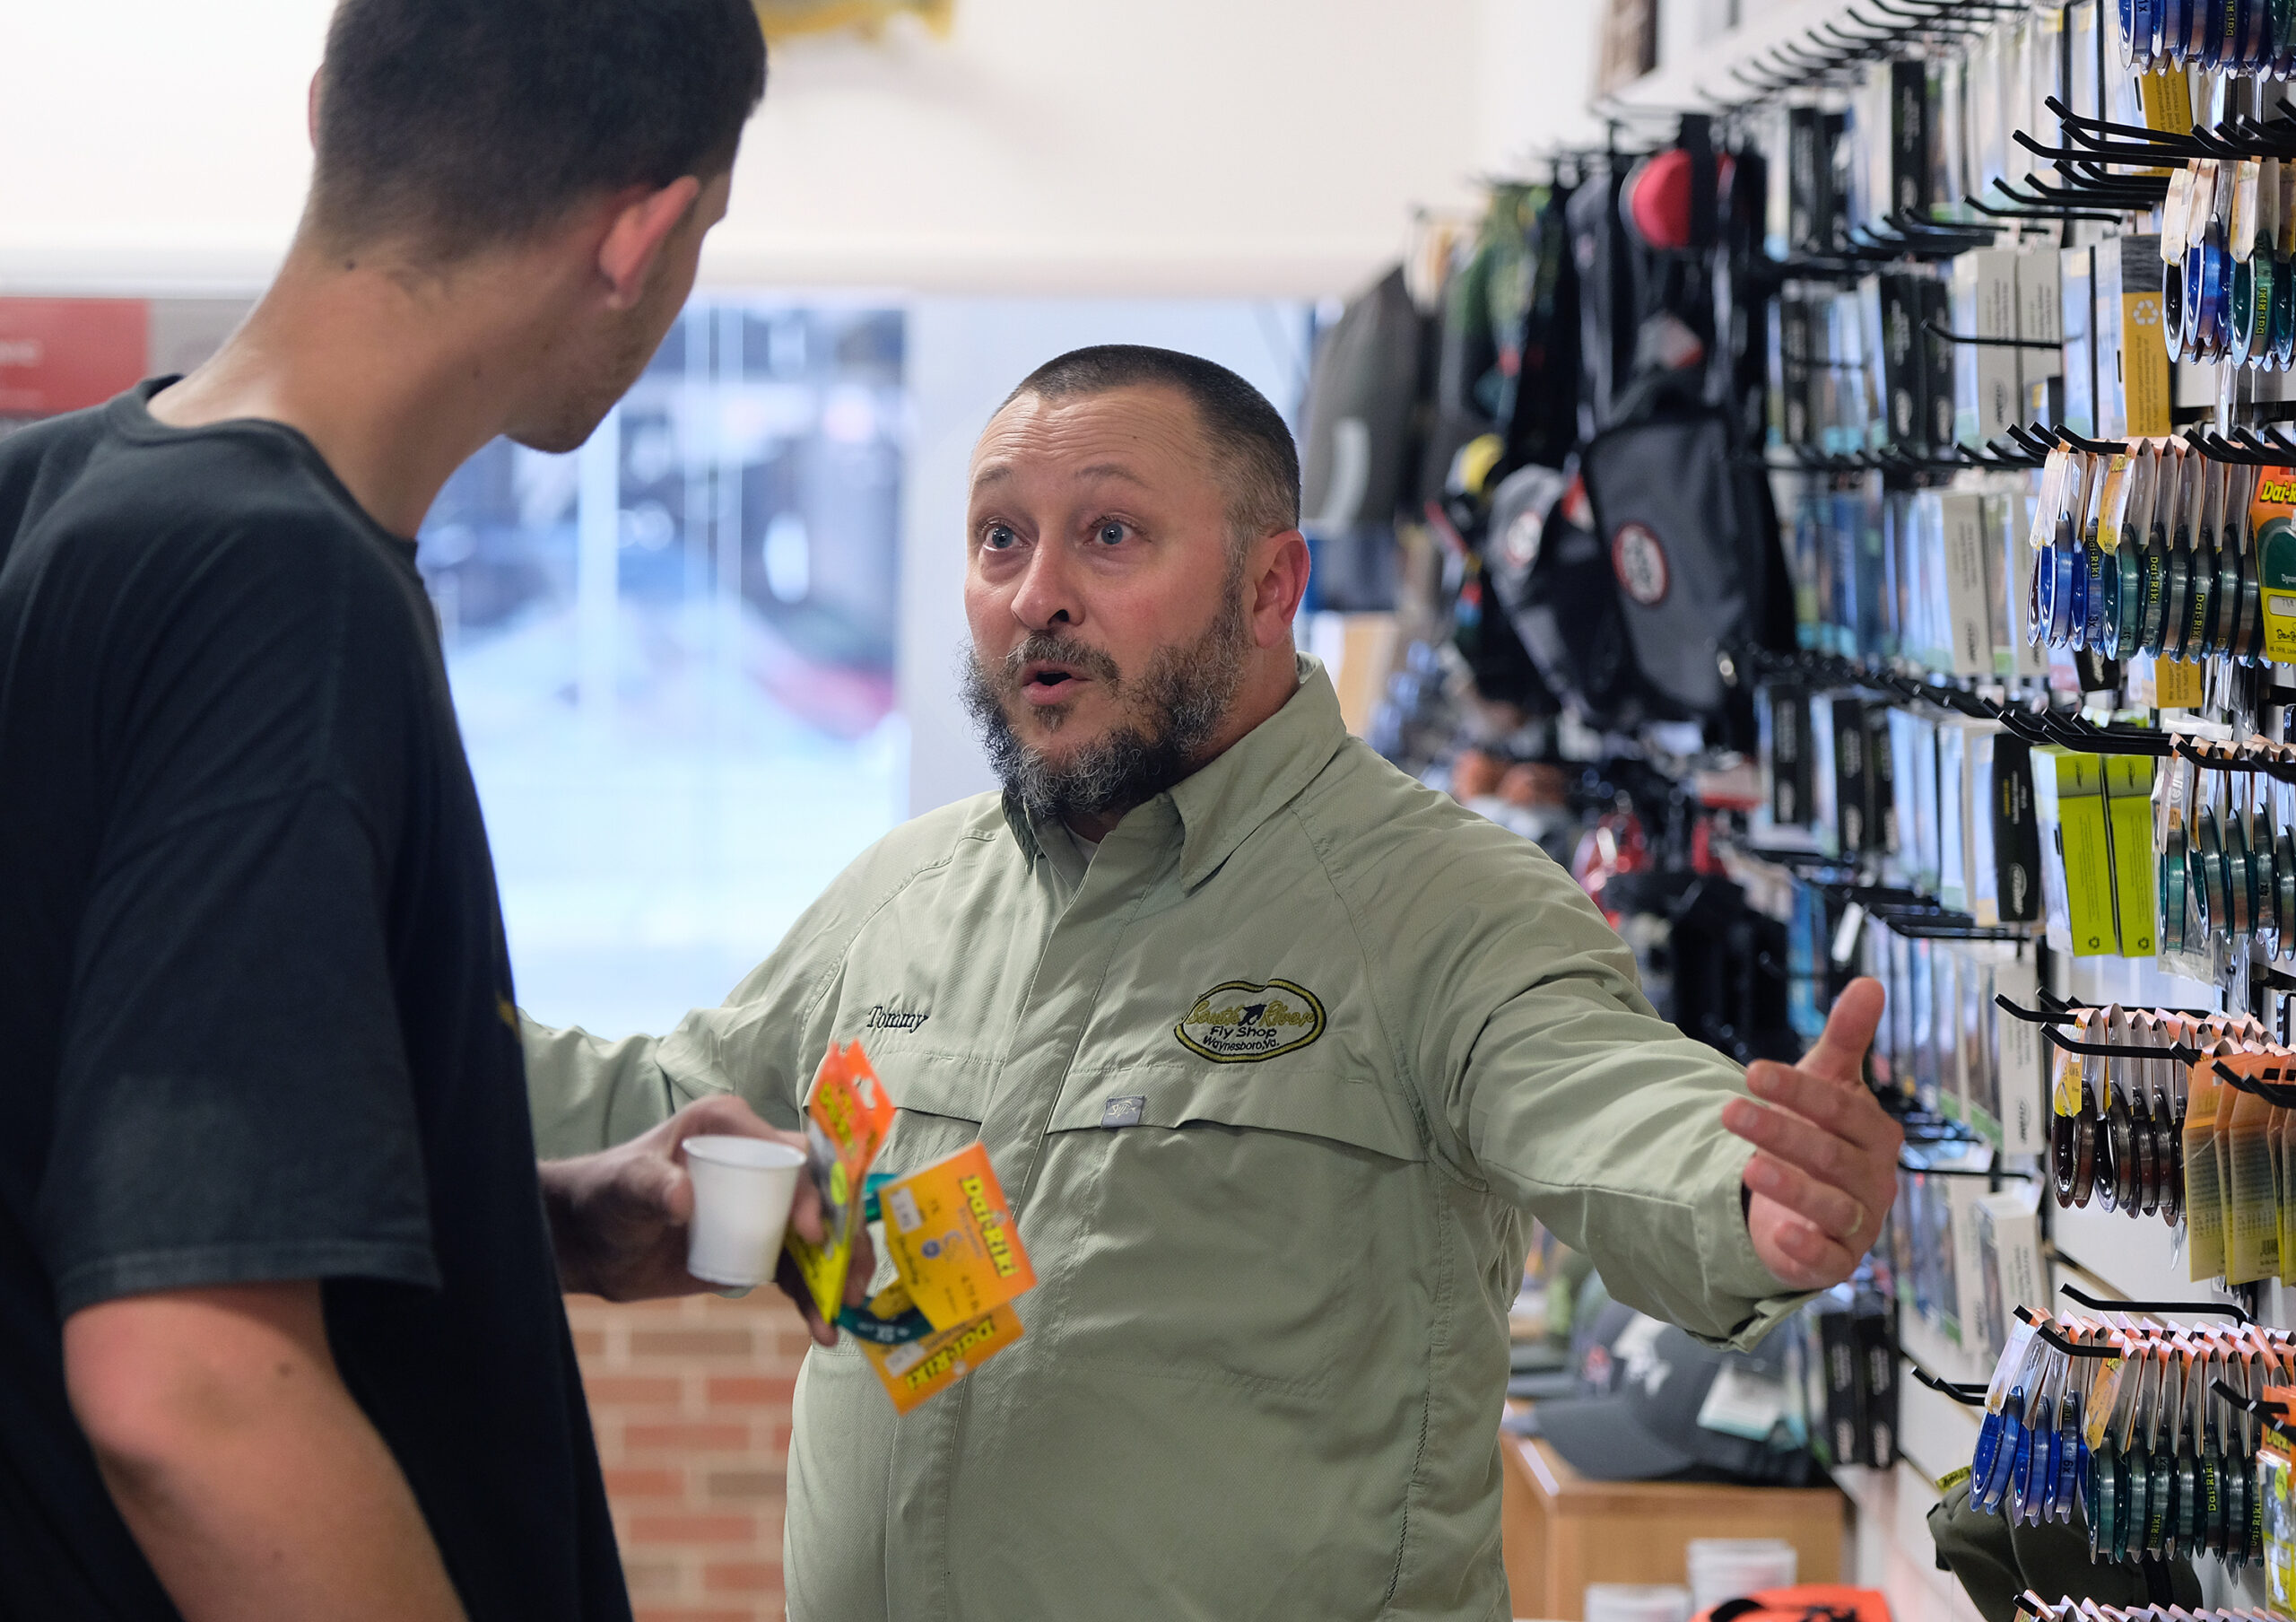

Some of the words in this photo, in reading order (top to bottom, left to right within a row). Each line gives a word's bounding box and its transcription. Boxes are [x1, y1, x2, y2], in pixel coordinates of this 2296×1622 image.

[2256, 287, 2267, 335] Dai-Riki
[2088, 536, 2100, 579] Dai-Riki
[2150, 556, 2160, 604] Dai-Riki
[2190, 593, 2205, 639] Dai-Riki
[866, 1006, 929, 1033] Tommy
[1186, 999, 1244, 1026] South
[1258, 999, 1316, 1027] River
[1209, 1025, 1234, 1040] Fly
[1236, 1026, 1277, 1040] Shop
[959, 1175, 1020, 1278] Dai-Riki
[906, 1316, 996, 1391] Dai-Riki
[2206, 1463, 2218, 1512] Dai-Riki
